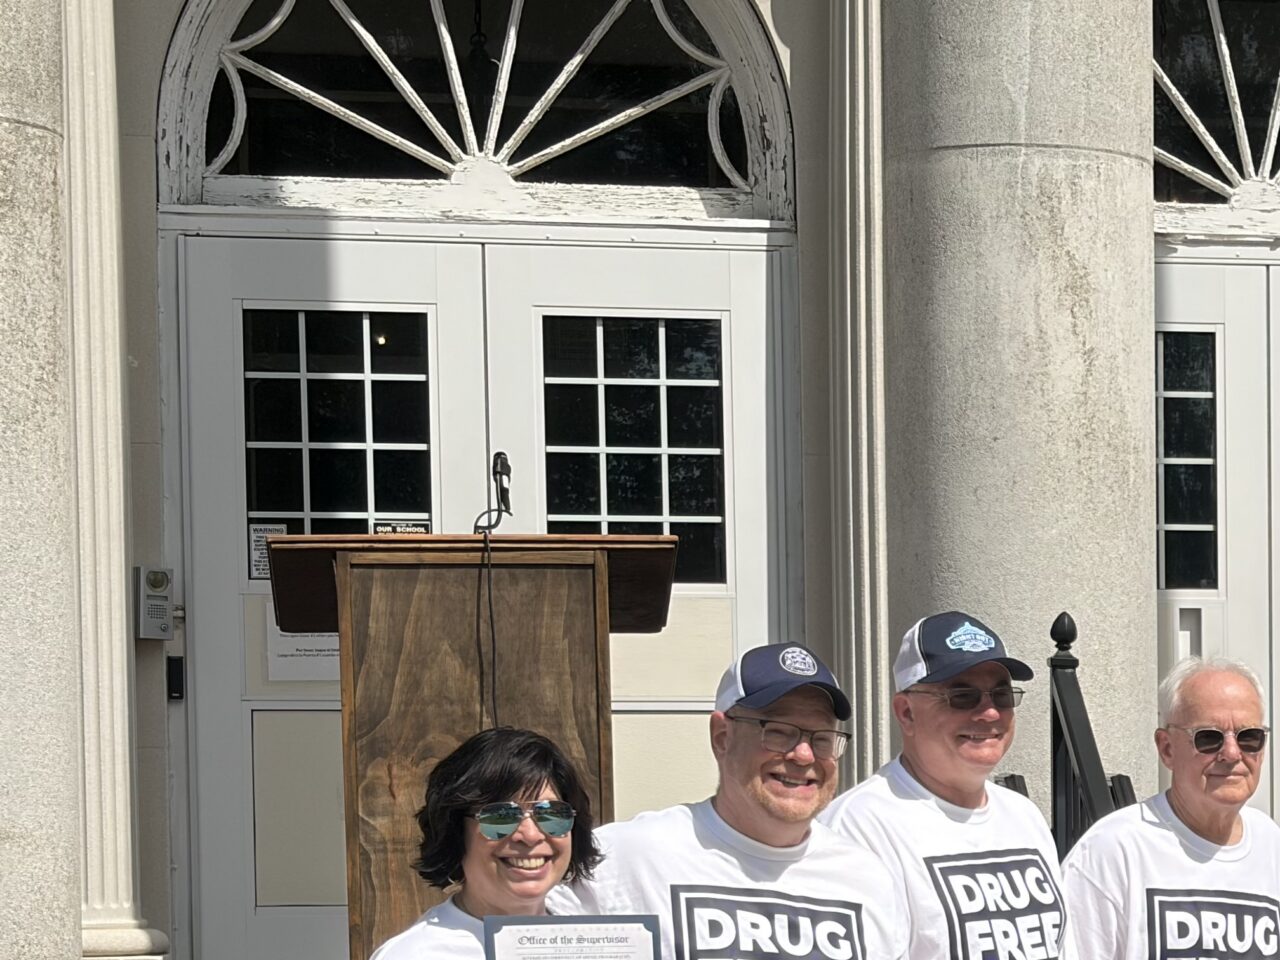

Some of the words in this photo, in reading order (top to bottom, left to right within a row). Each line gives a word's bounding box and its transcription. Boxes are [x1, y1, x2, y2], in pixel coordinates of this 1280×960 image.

[948, 866, 1056, 915] DRUG
[517, 935, 548, 946] Office
[550, 935, 559, 945] of
[560, 935, 574, 946] the
[576, 935, 630, 945] Supervisor
[694, 907, 852, 960] DRUG
[1167, 910, 1279, 956] DRUG
